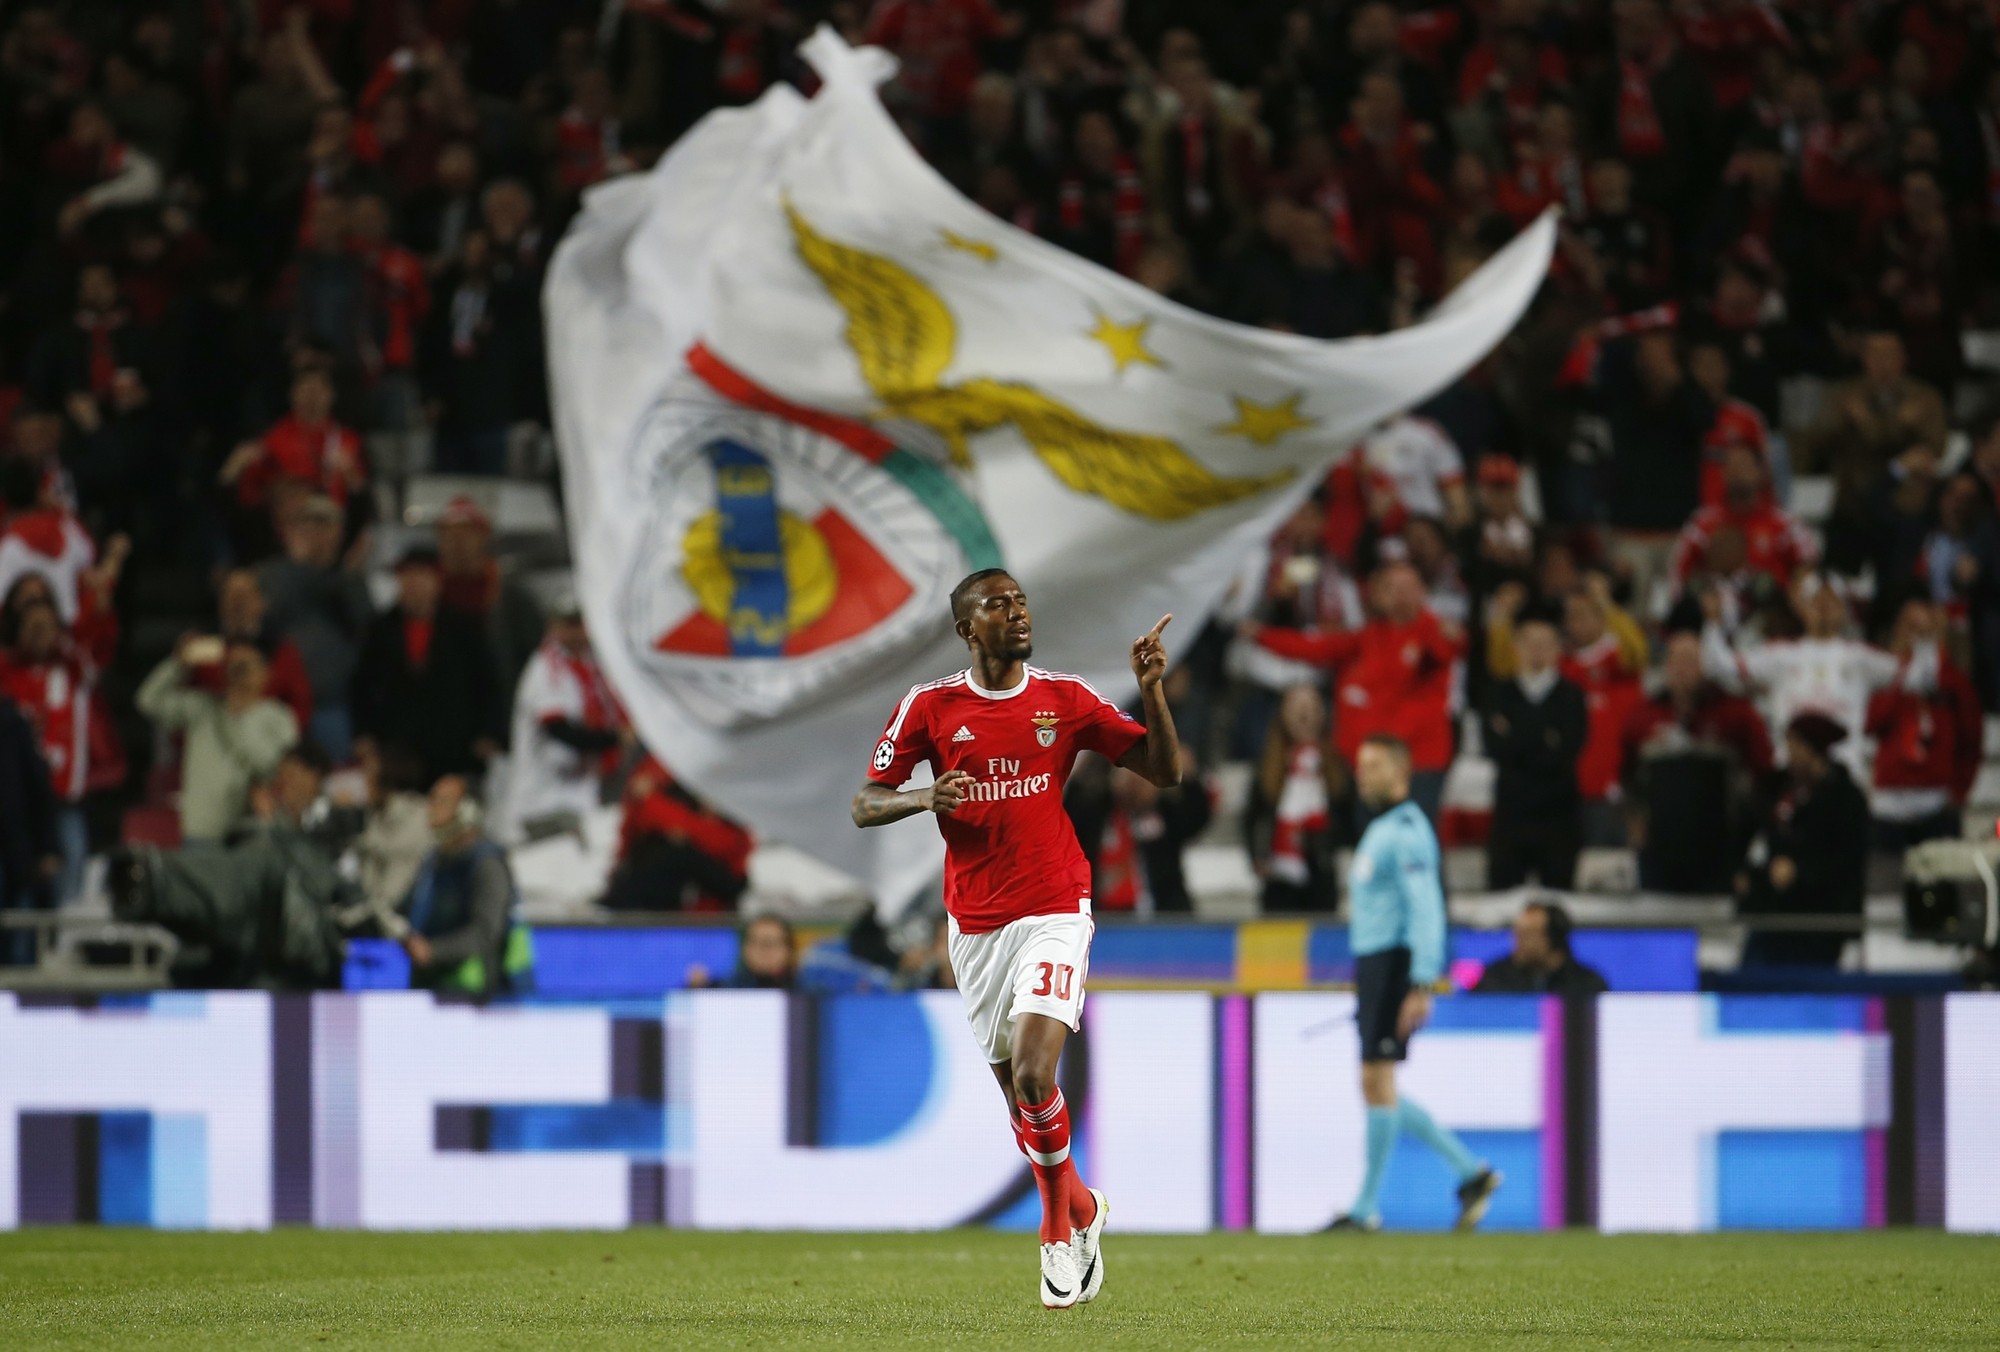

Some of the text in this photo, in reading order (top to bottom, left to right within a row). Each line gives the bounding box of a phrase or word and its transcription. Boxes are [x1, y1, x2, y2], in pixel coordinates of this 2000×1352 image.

[988, 758, 1020, 776] Fly
[956, 773, 1051, 801] mirates
[1031, 962, 1074, 1001] 30
